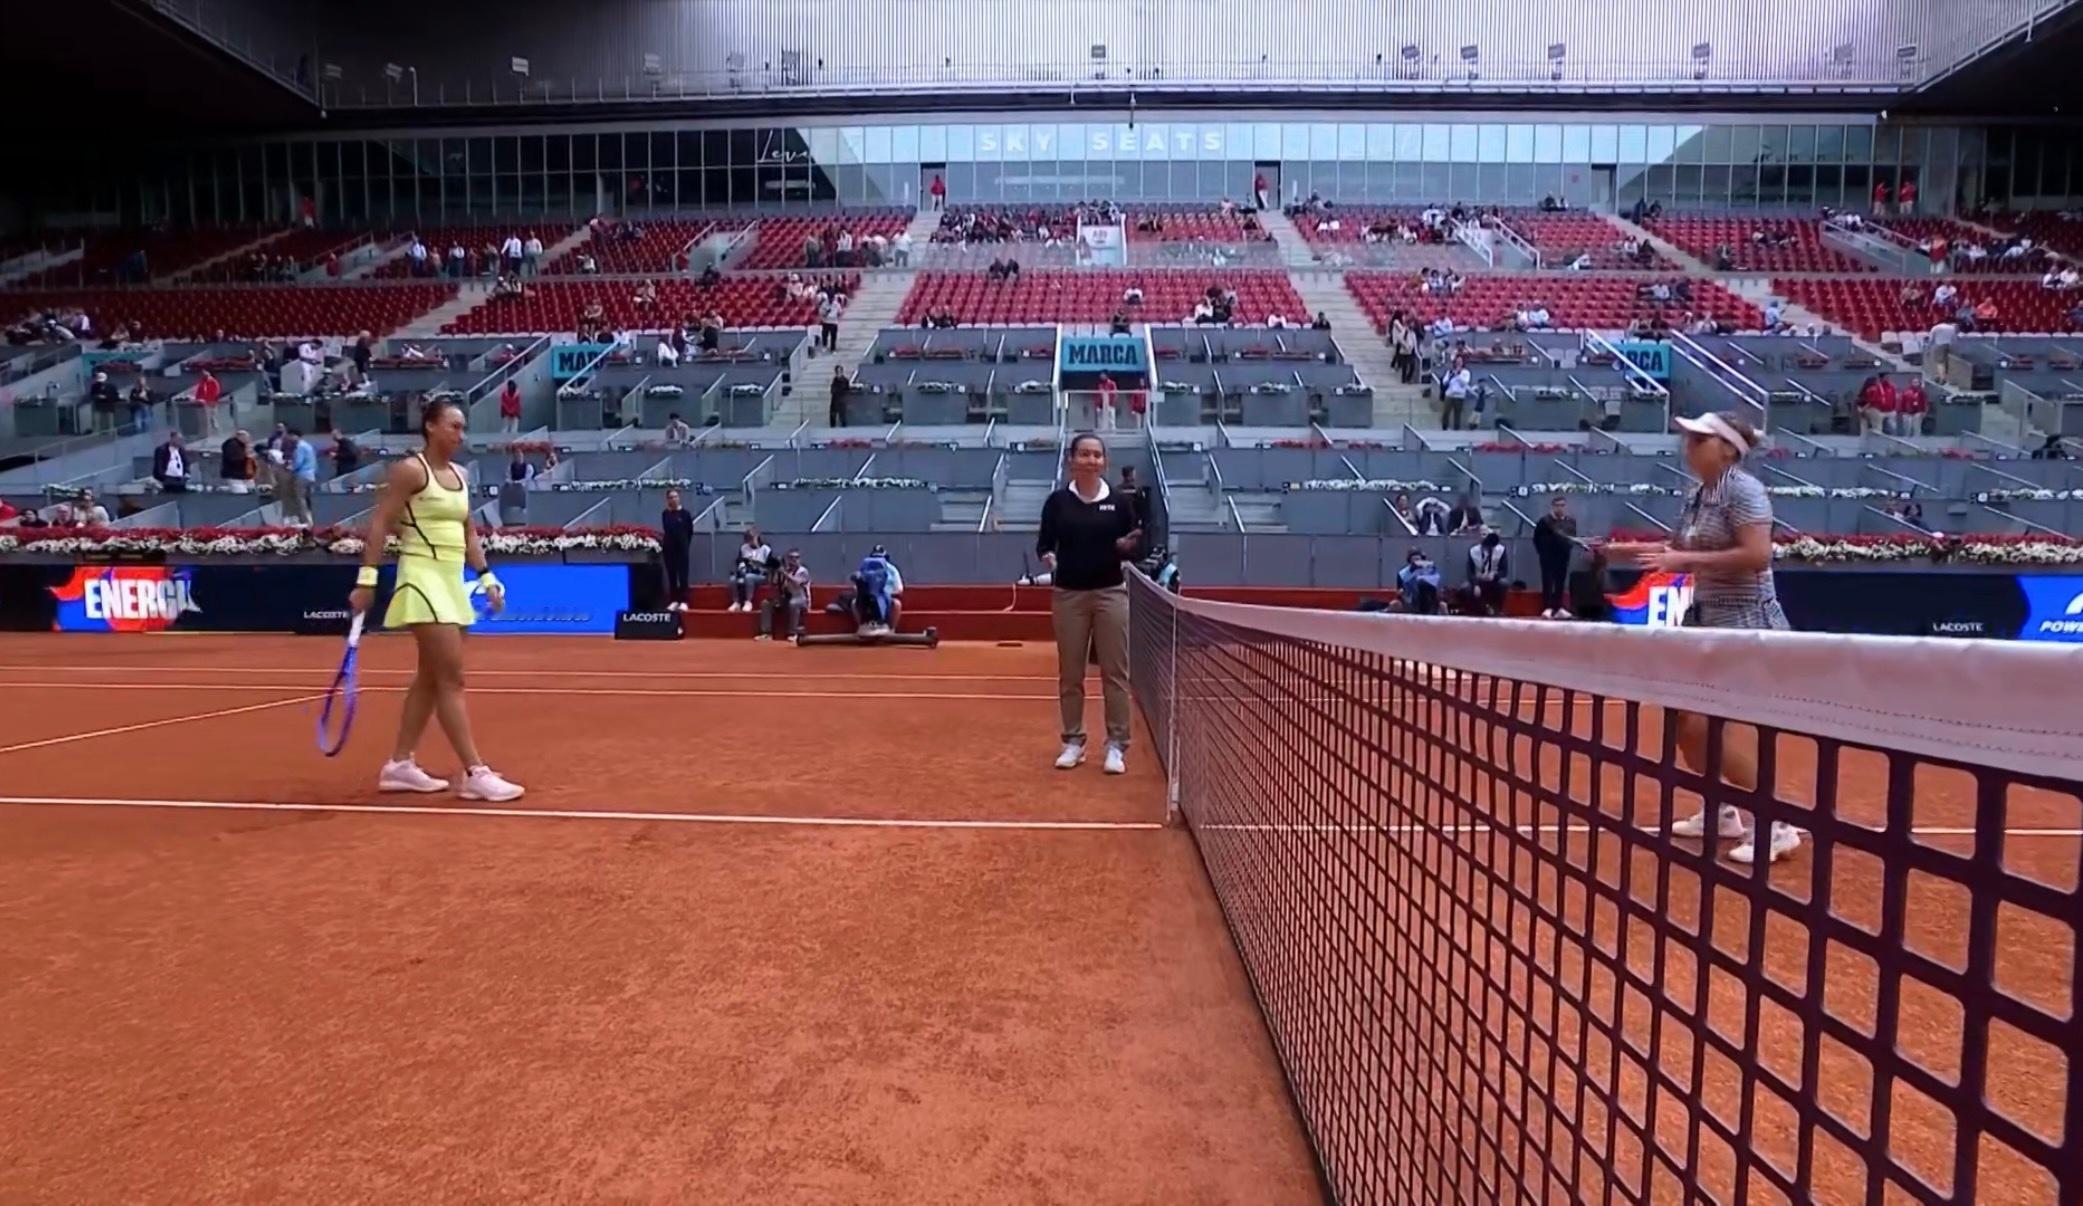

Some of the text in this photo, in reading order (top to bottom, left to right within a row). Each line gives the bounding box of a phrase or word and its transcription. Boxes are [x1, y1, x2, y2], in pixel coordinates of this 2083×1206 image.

[981, 132, 1221, 151] SKY SEATS
[559, 351, 604, 372] MAR
[1068, 344, 1138, 365] MARCA
[1622, 350, 1663, 372] RCA
[1648, 586, 1694, 626] EN
[623, 613, 671, 623] LACOSTE
[1933, 622, 1983, 632] LACOSTE
